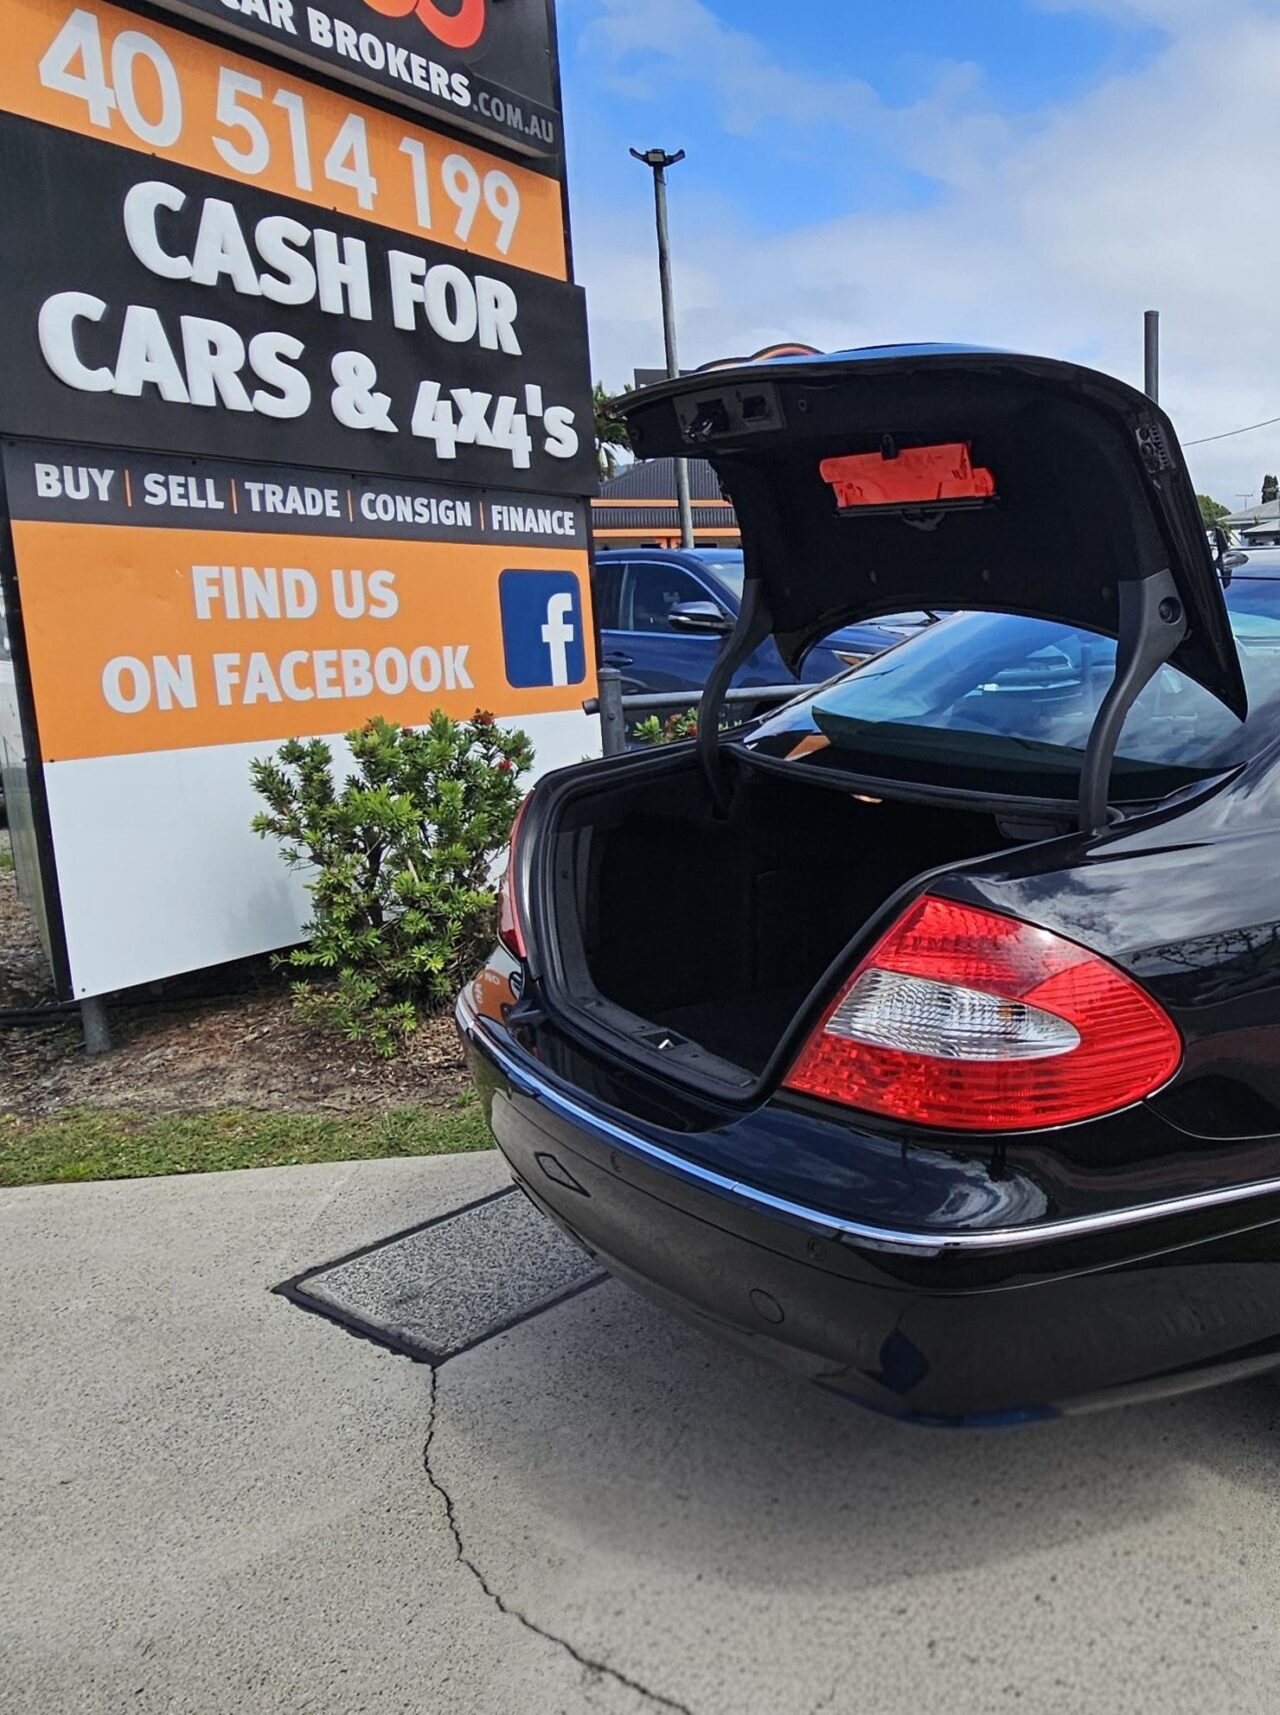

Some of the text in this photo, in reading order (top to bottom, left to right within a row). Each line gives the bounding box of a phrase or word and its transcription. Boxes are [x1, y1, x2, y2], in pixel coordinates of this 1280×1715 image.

[221, 0, 297, 34] AR
[38, 8, 520, 255] 40 514 199
[123, 181, 522, 356] CASH FOR
[38, 291, 311, 419] CARS
[331, 350, 399, 433] &
[35, 463, 576, 536] BUY SELL TRADE CONSIGN FINANCE
[191, 565, 399, 620] FIND US
[101, 645, 475, 714] ON FACEBOOK
